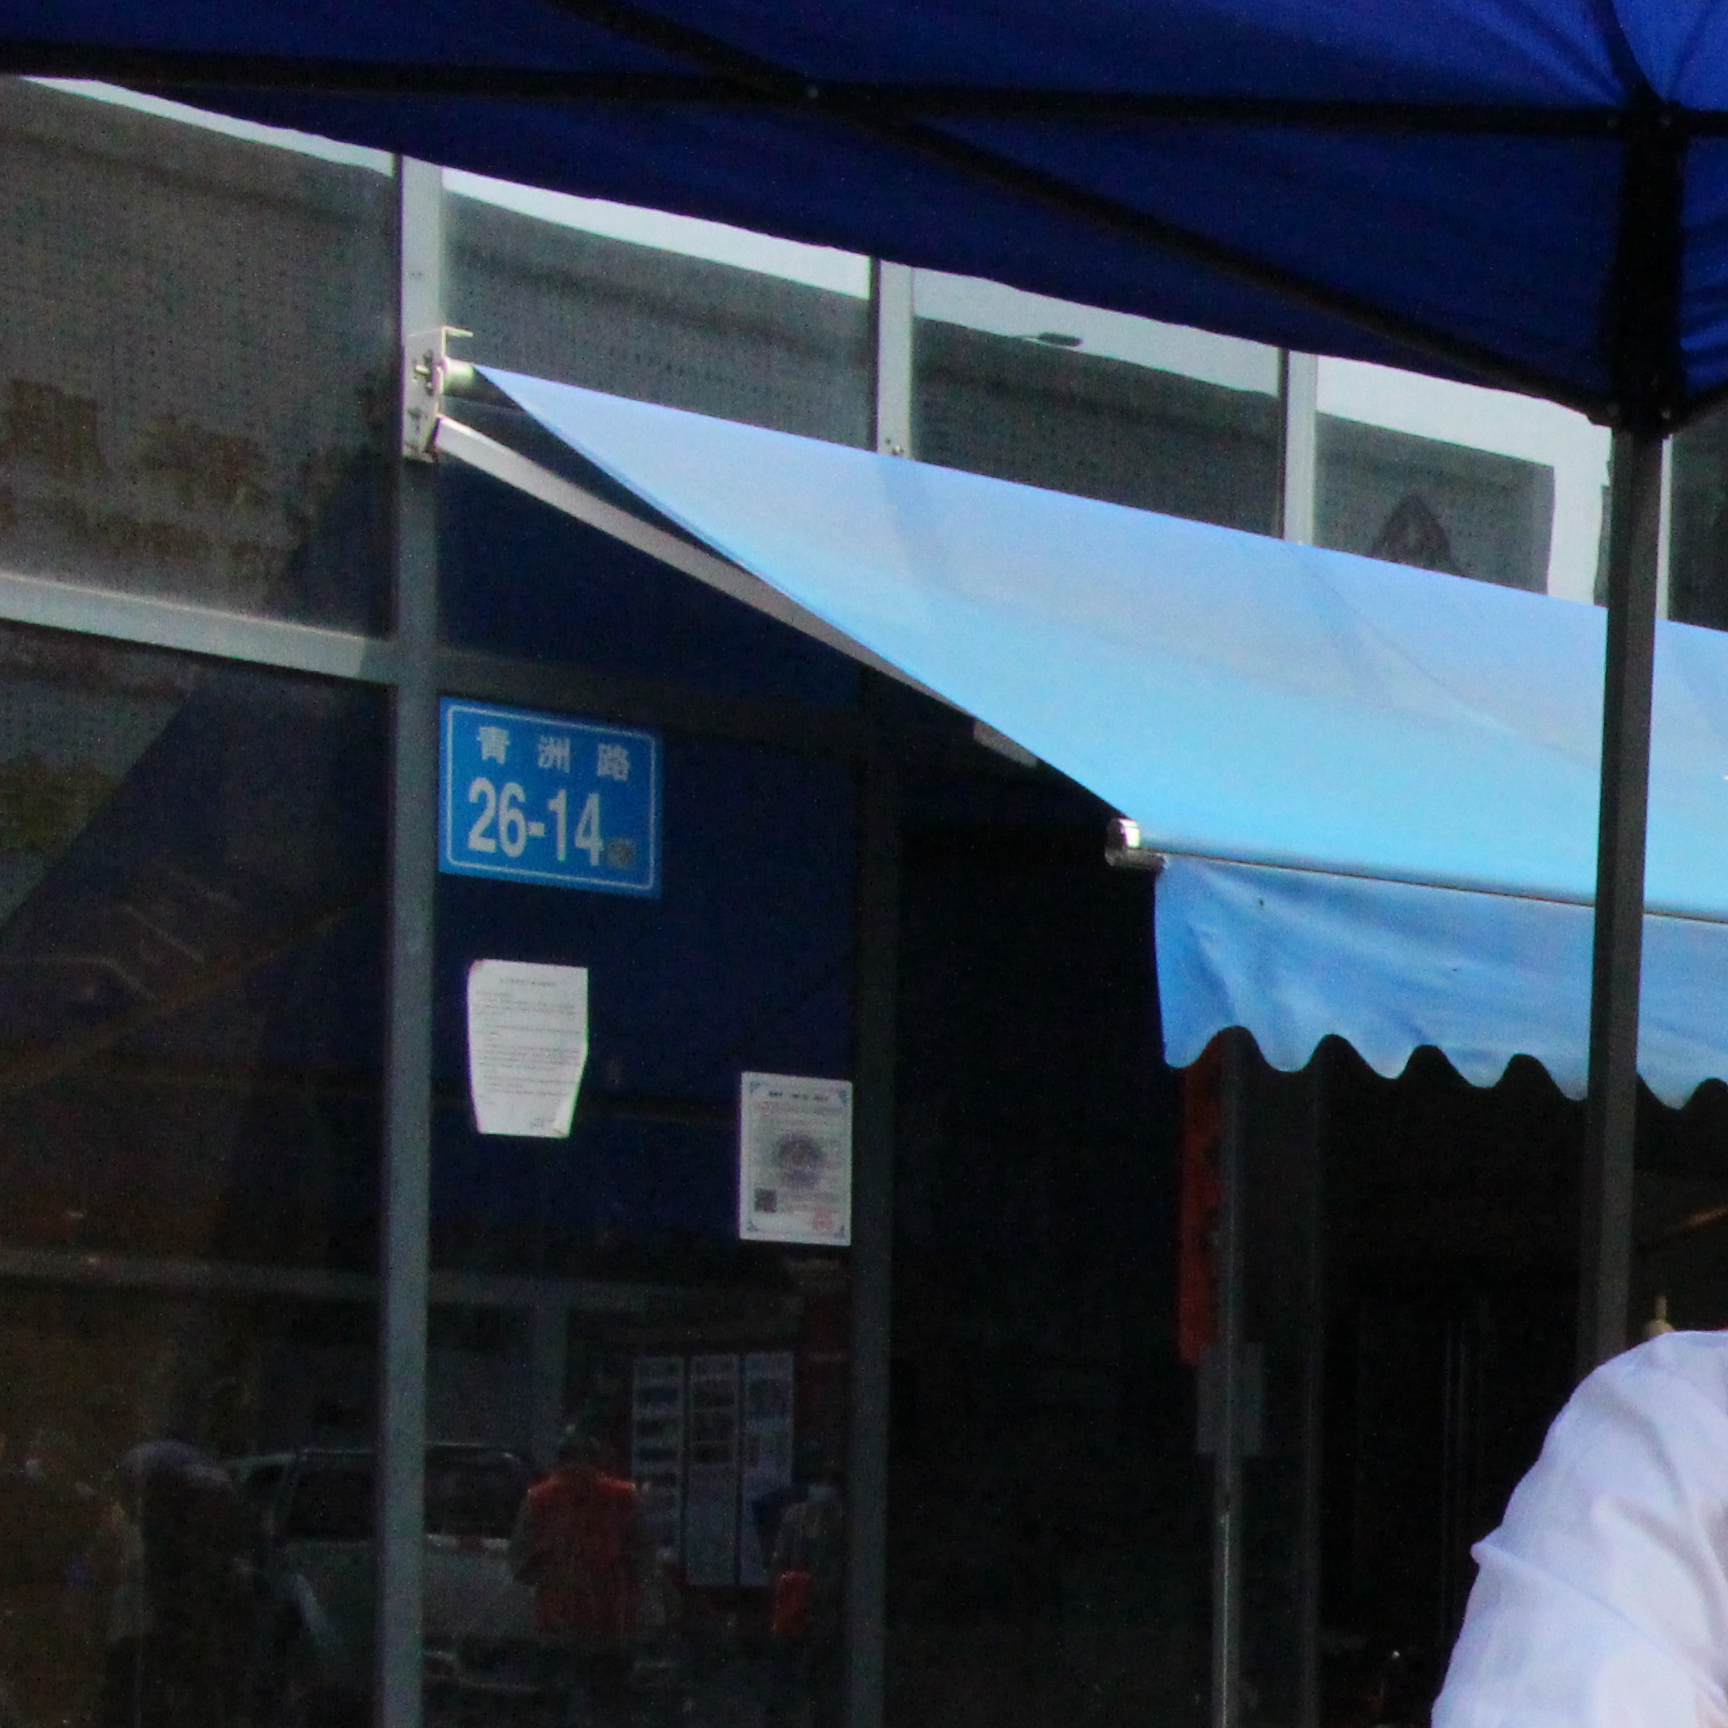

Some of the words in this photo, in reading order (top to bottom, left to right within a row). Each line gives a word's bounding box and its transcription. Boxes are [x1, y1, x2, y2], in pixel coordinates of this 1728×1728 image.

[477, 726, 631, 781] 青洲路
[467, 776, 604, 867] 26-14
